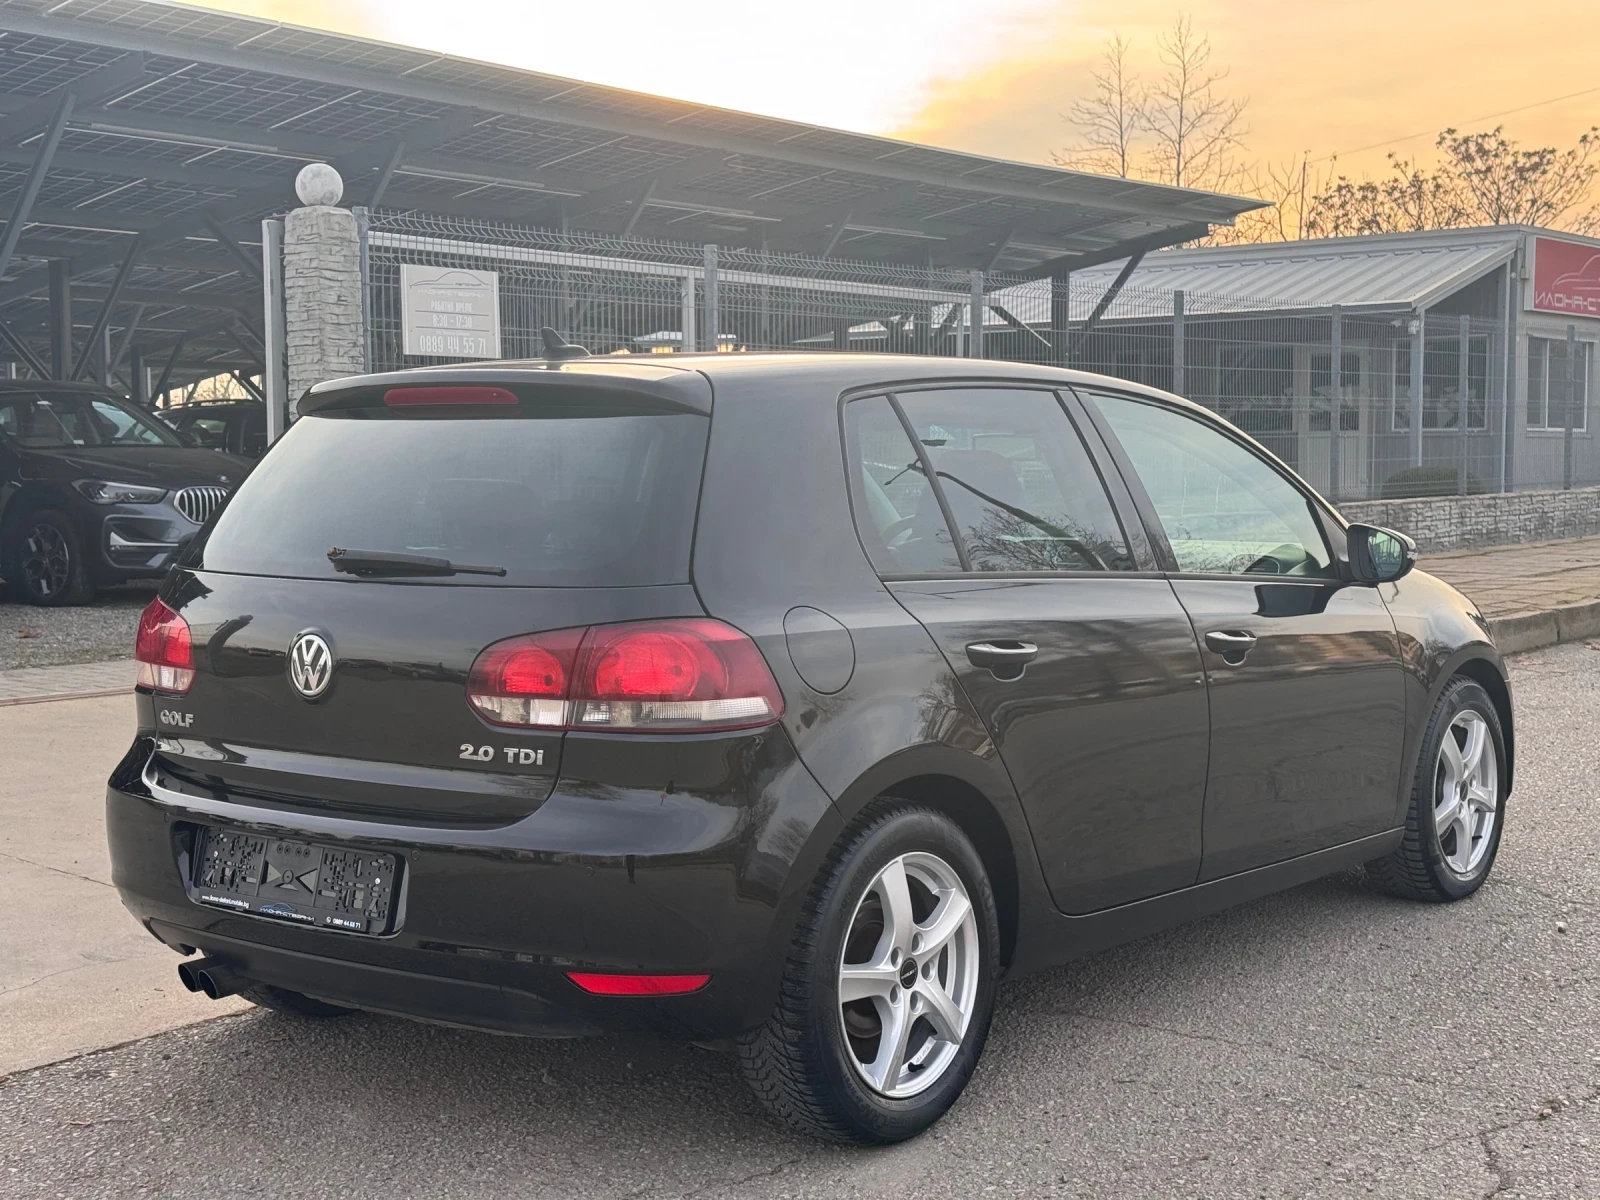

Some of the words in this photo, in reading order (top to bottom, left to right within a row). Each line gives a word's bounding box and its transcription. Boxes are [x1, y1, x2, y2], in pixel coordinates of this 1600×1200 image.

[1535, 290, 1600, 311] ИЛОНА-С
[420, 334, 444, 353] 0889
[447, 335, 460, 354] 44
[463, 337, 475, 355] 55
[478, 337, 487, 355] 71
[160, 709, 194, 728] GOLF
[459, 743, 495, 762] 2.0
